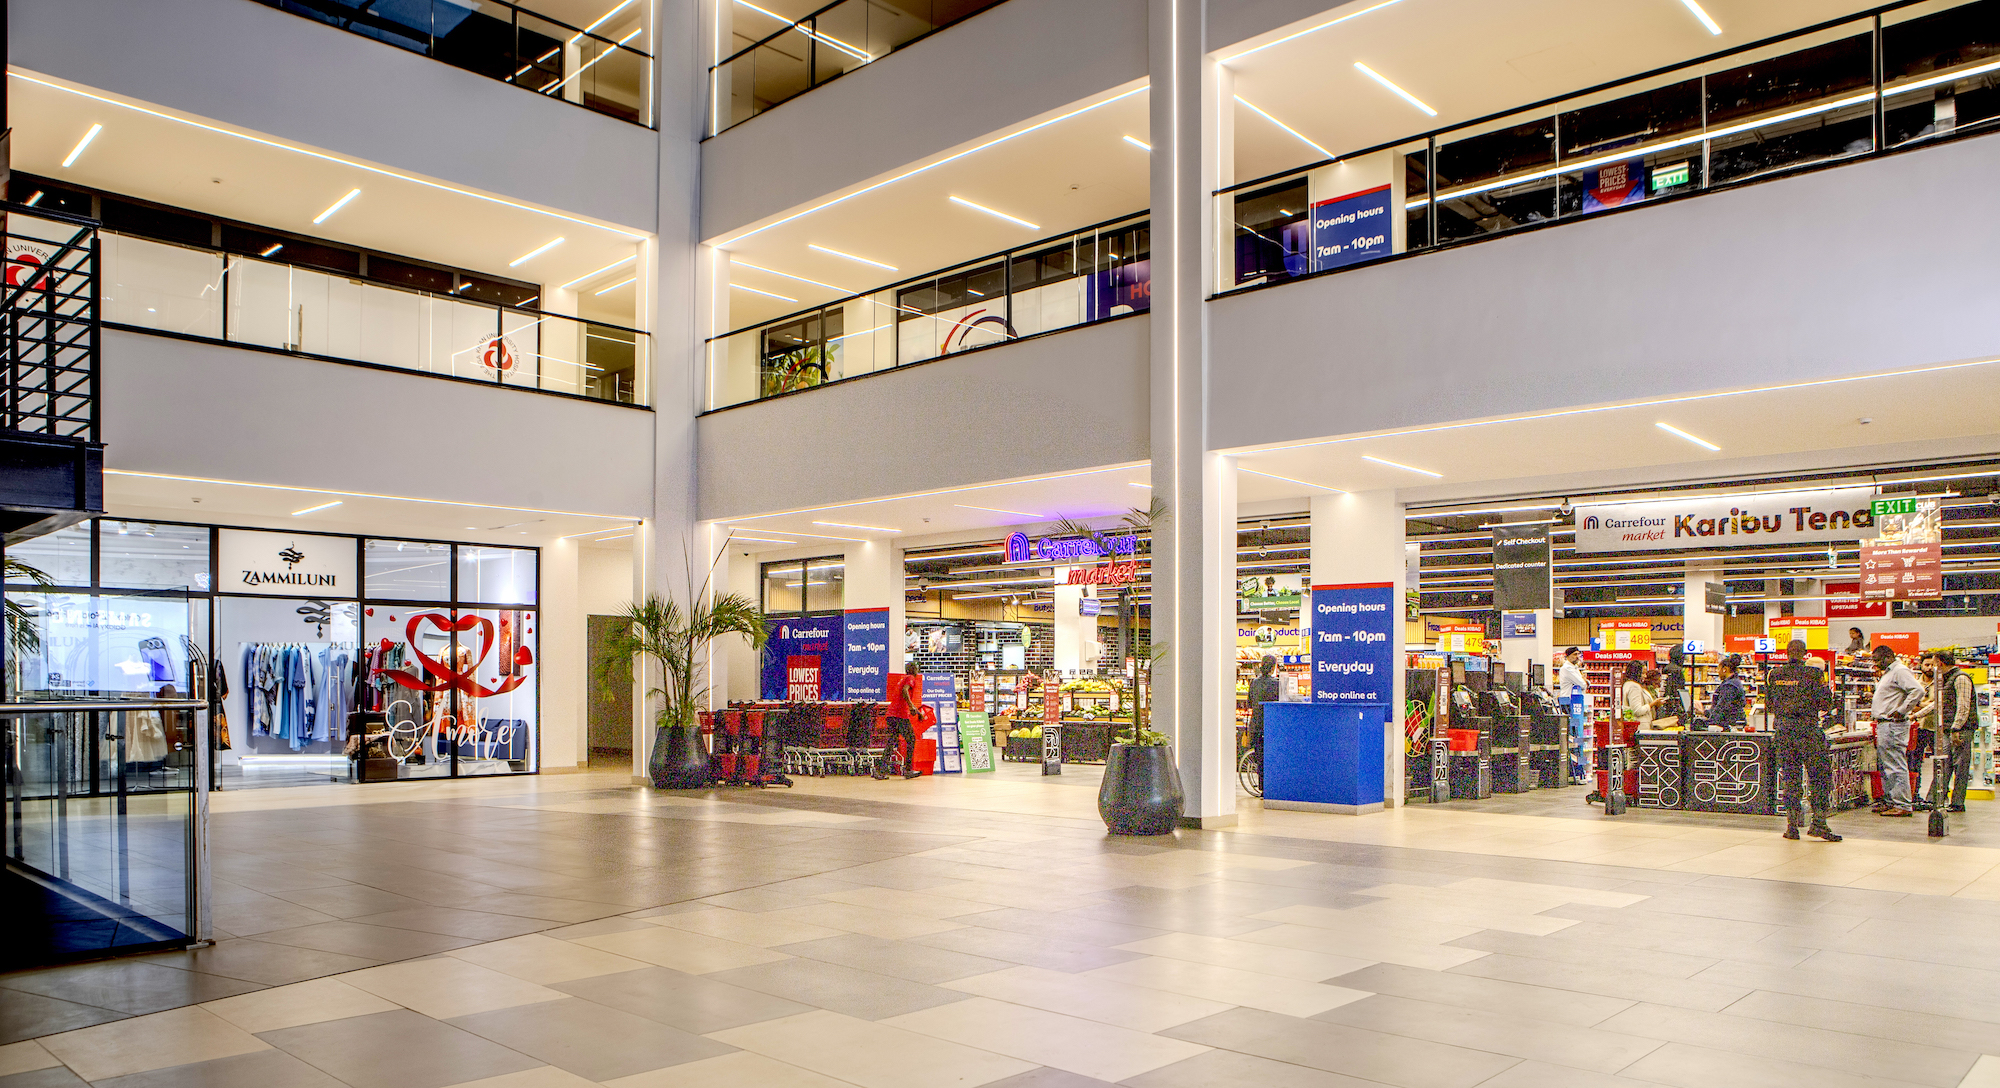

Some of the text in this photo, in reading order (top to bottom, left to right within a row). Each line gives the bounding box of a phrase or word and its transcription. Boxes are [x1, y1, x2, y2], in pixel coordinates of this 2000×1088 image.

[1600, 164, 1627, 178] LOWEST
[1600, 174, 1627, 188] PRICES
[1656, 173, 1684, 187] EXIT
[1316, 206, 1384, 230] Opening hours
[1316, 244, 1342, 258] 7am
[1351, 234, 1384, 250] 10pm
[1875, 500, 1912, 514] EXIT
[1605, 517, 1666, 529] Carrefour
[1674, 507, 1782, 538] Karibu
[1516, 537, 1546, 546] Checkout
[1622, 530, 1666, 542] market
[1037, 532, 1138, 559] Carrefour
[1067, 558, 1138, 586] market
[1496, 562, 1524, 570] Dedicated
[242, 570, 336, 586] ZAMMILUNI
[1317, 602, 1386, 614] Opening hours
[792, 627, 830, 638] Carrefour
[847, 622, 869, 631] Opening
[1317, 631, 1342, 642] 7am
[1352, 630, 1386, 644] 10pm
[1465, 637, 1483, 648] 479
[1630, 634, 1650, 645] 489
[802, 640, 829, 652] market
[847, 643, 862, 652] 7am
[867, 642, 886, 652] 10pm
[1687, 640, 1696, 652] 6
[1760, 639, 1768, 651] 5
[848, 665, 879, 675] Everyday
[1318, 660, 1374, 675] Everyday
[789, 667, 818, 683] LOWEST
[789, 684, 818, 702] PRICES
[1317, 690, 1338, 700] Shop
[1339, 690, 1365, 699] online
[386, 700, 516, 760] Amore
